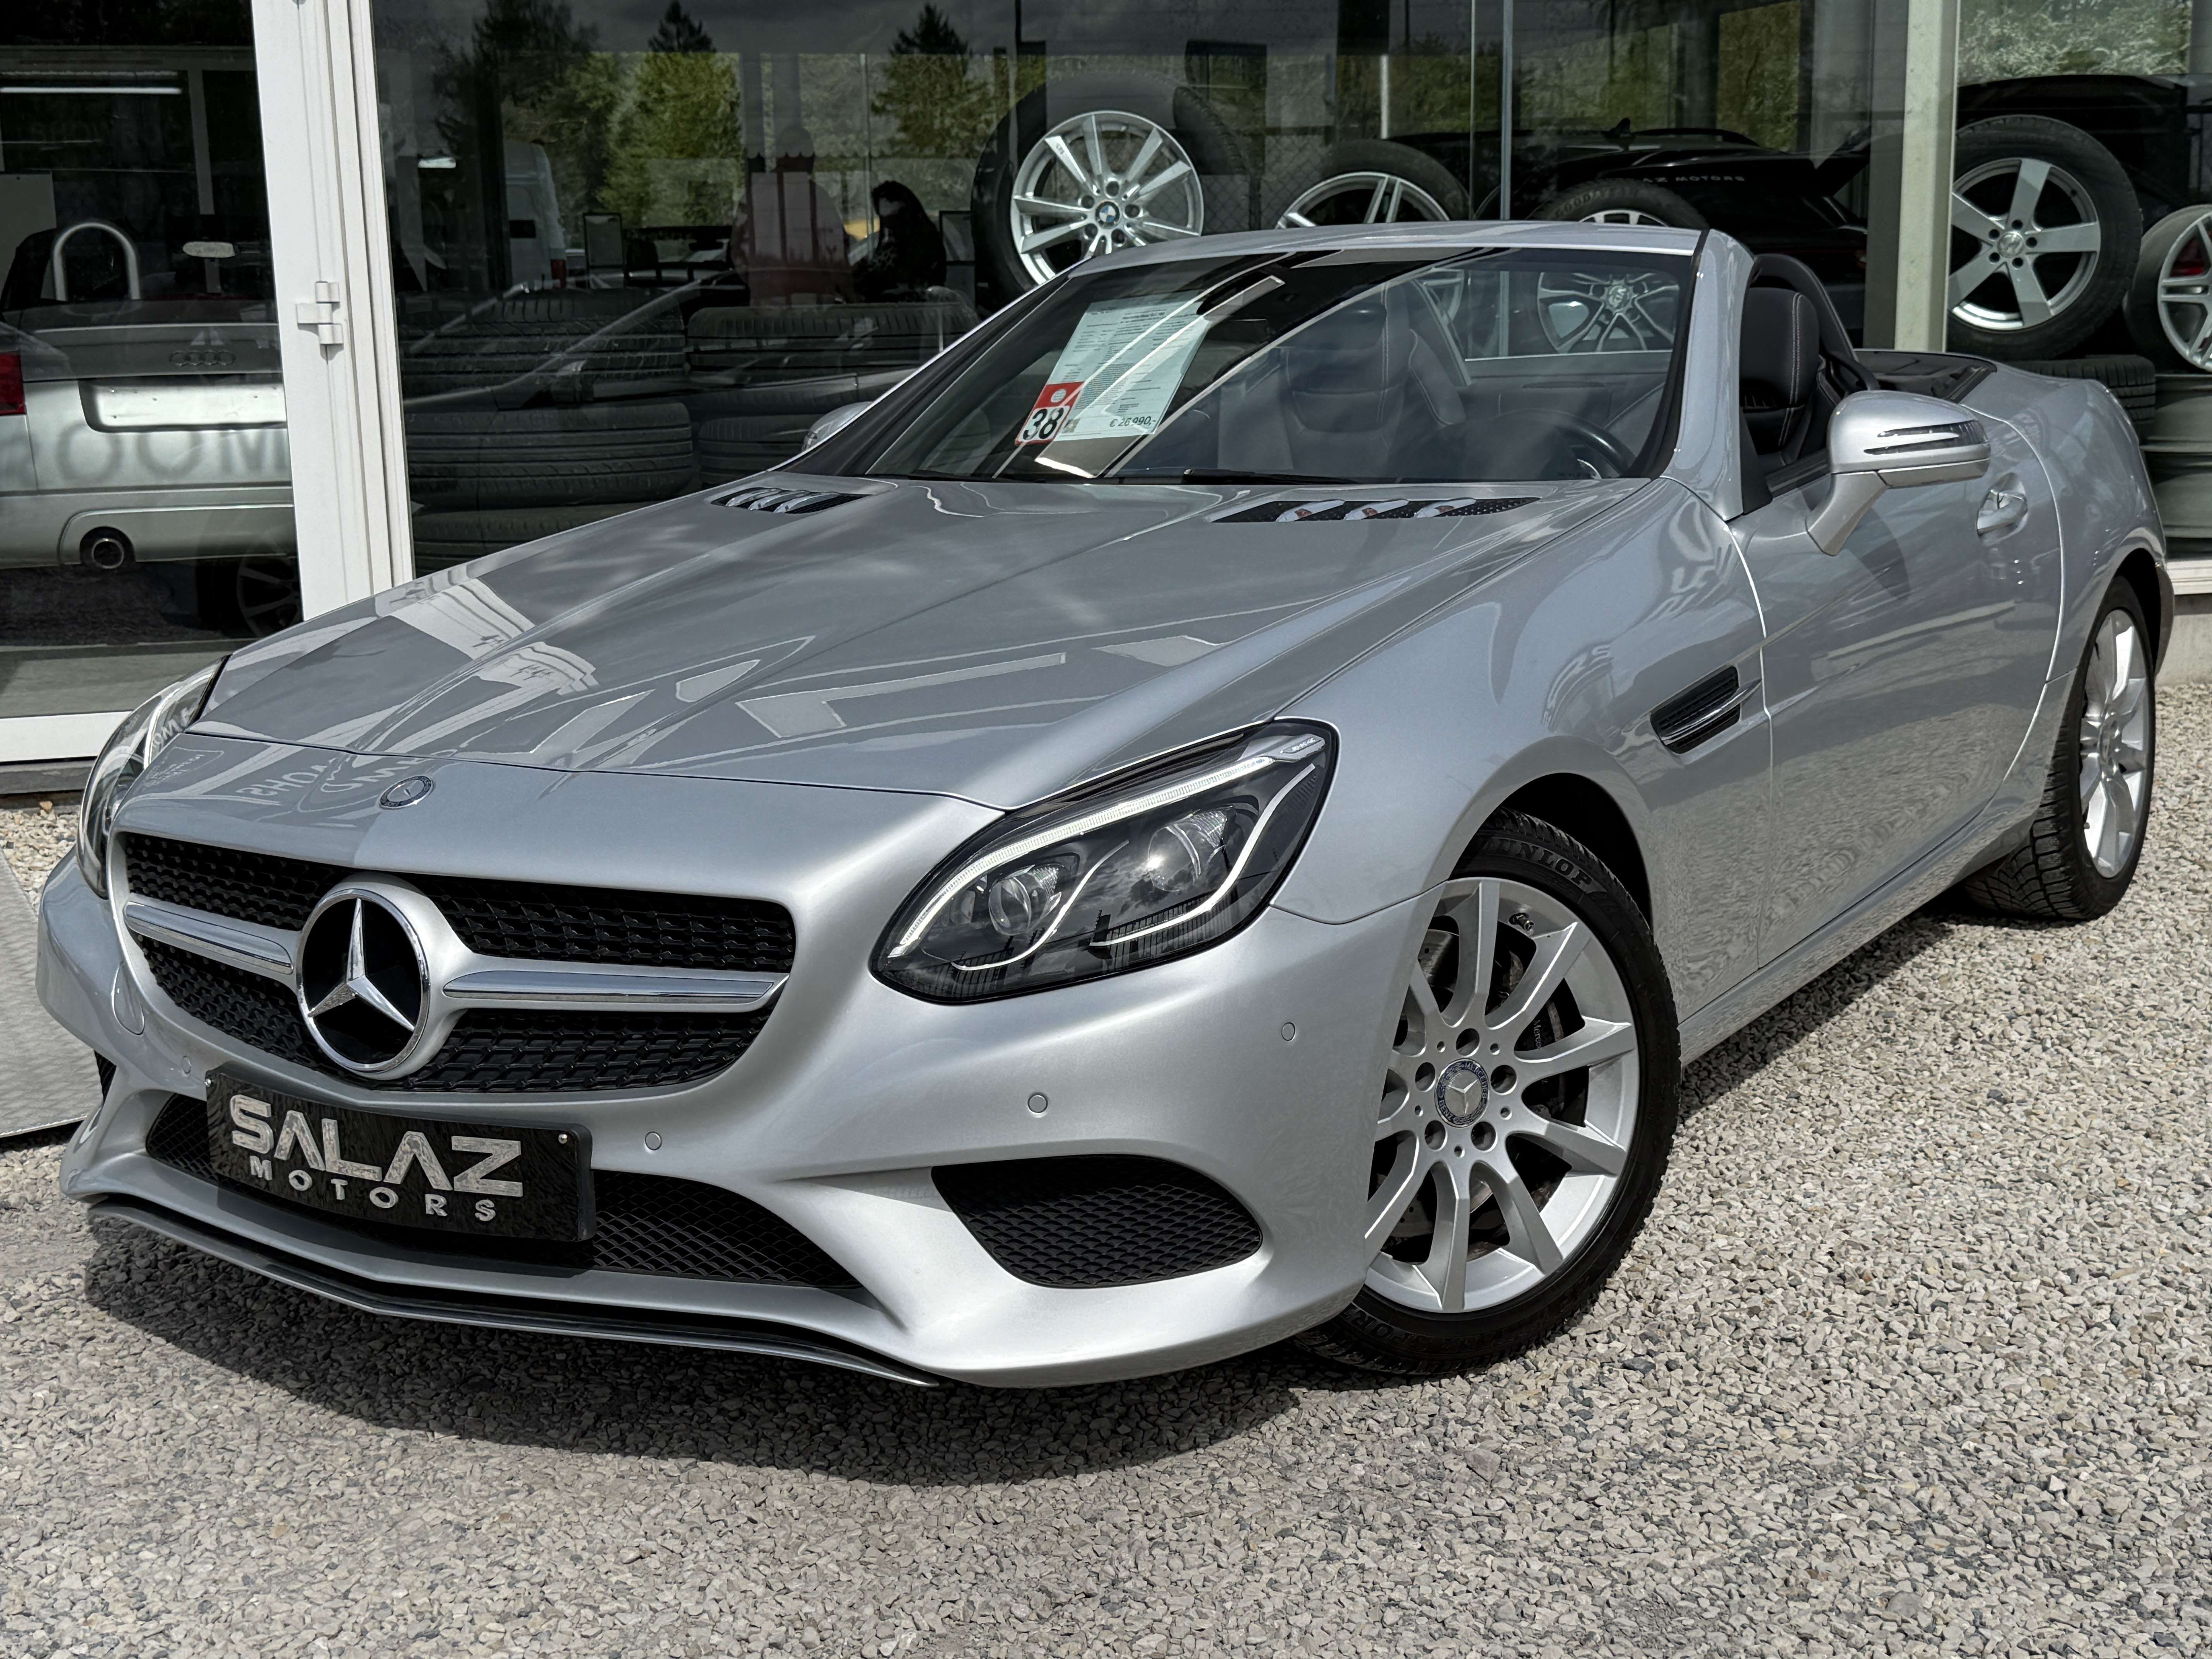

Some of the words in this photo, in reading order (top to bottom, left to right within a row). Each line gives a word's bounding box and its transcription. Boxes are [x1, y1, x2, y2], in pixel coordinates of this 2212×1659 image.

[1023, 407, 1064, 440] 38
[230, 1094, 524, 1197] SALAZ
[249, 1156, 496, 1222] MOTORS
